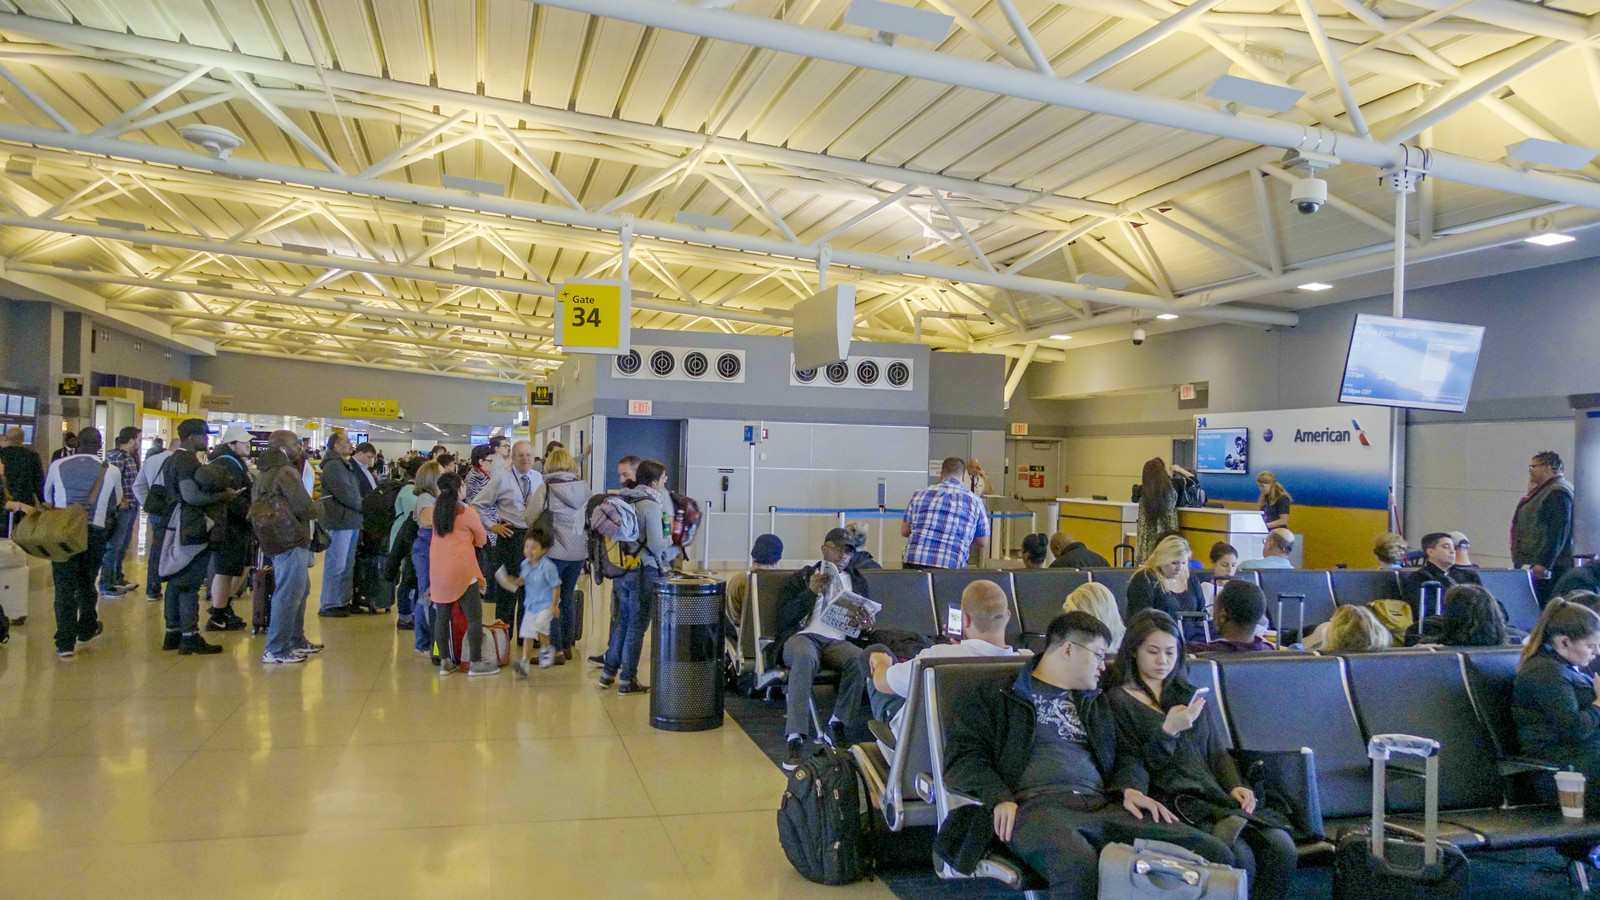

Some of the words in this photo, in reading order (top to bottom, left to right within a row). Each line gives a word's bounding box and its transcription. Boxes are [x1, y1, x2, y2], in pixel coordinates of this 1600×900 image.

[572, 295, 595, 304] Gate
[572, 306, 601, 328] 34
[1379, 328, 1394, 337] Fort
[1395, 331, 1418, 340] Worth
[633, 401, 648, 414] EXIT
[1197, 417, 1207, 428] 34
[1294, 427, 1350, 442] American
[825, 609, 851, 625] SUNDAY
[820, 615, 858, 635] MASSACRE
